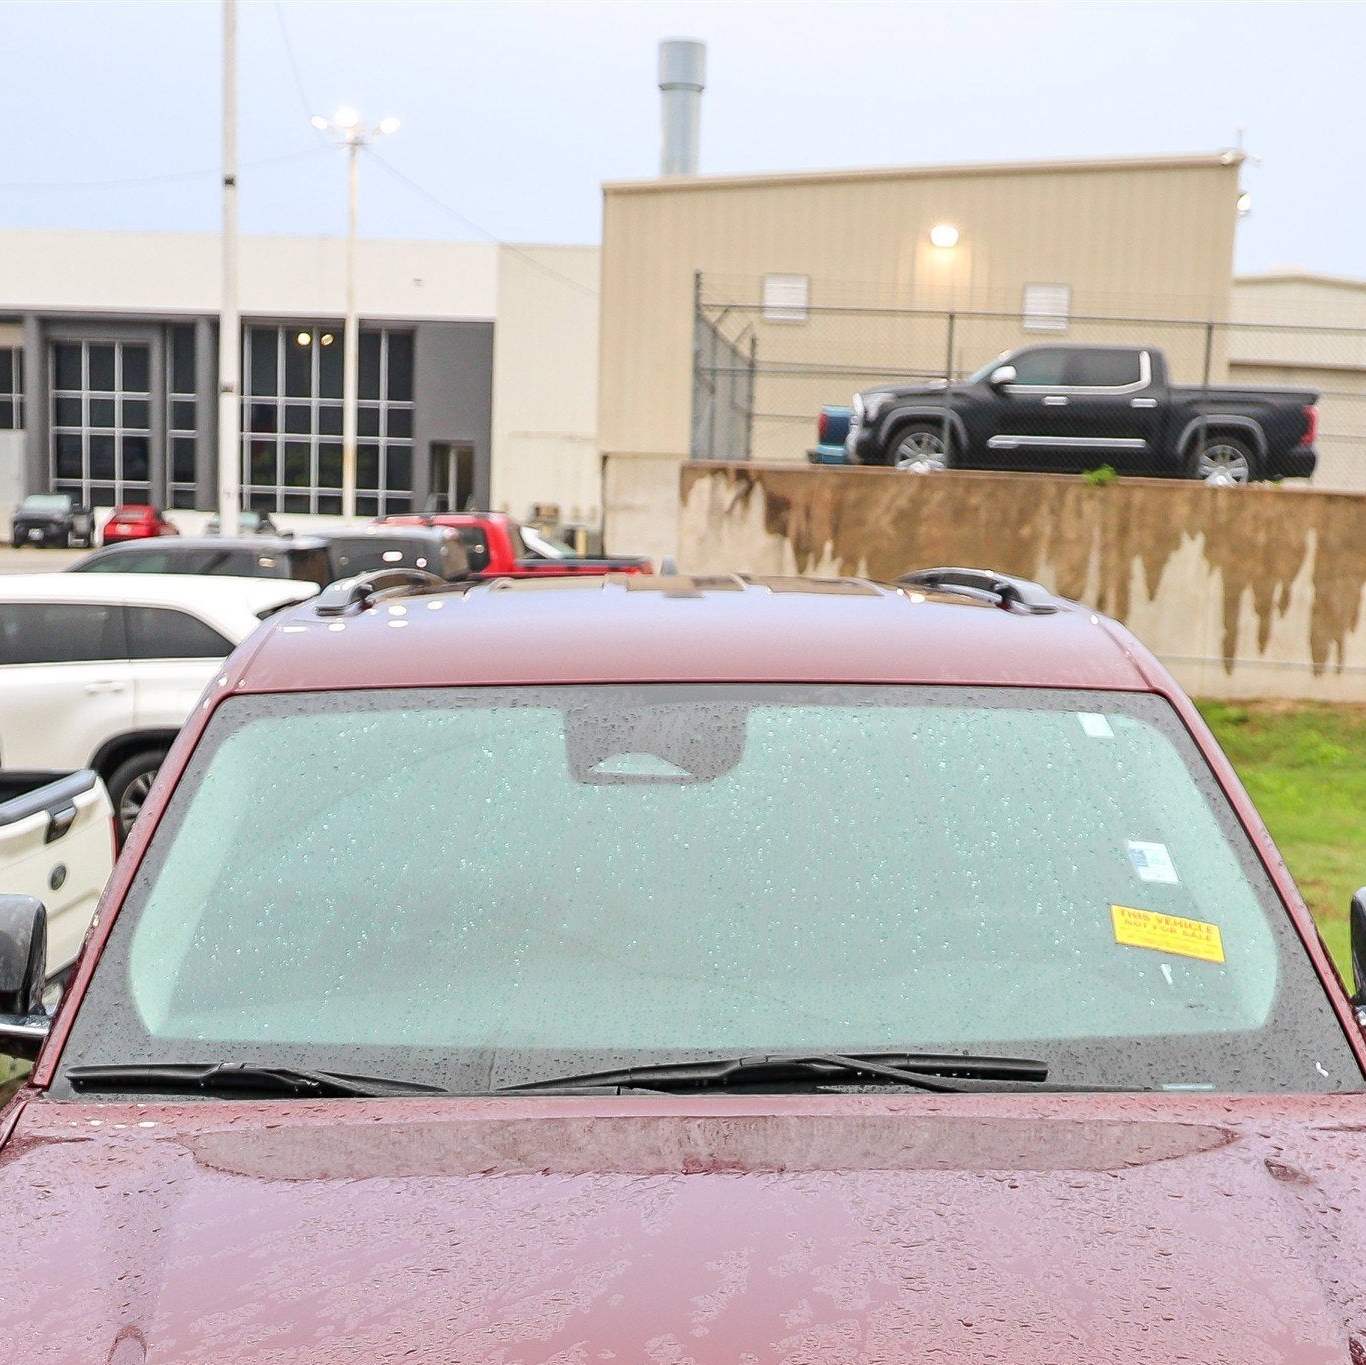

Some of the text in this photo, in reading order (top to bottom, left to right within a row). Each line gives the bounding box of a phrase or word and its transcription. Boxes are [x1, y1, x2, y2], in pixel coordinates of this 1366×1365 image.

[1121, 909, 1214, 934] THIS VEHICLE
[1123, 918, 1212, 942] NOT FOR SALE
